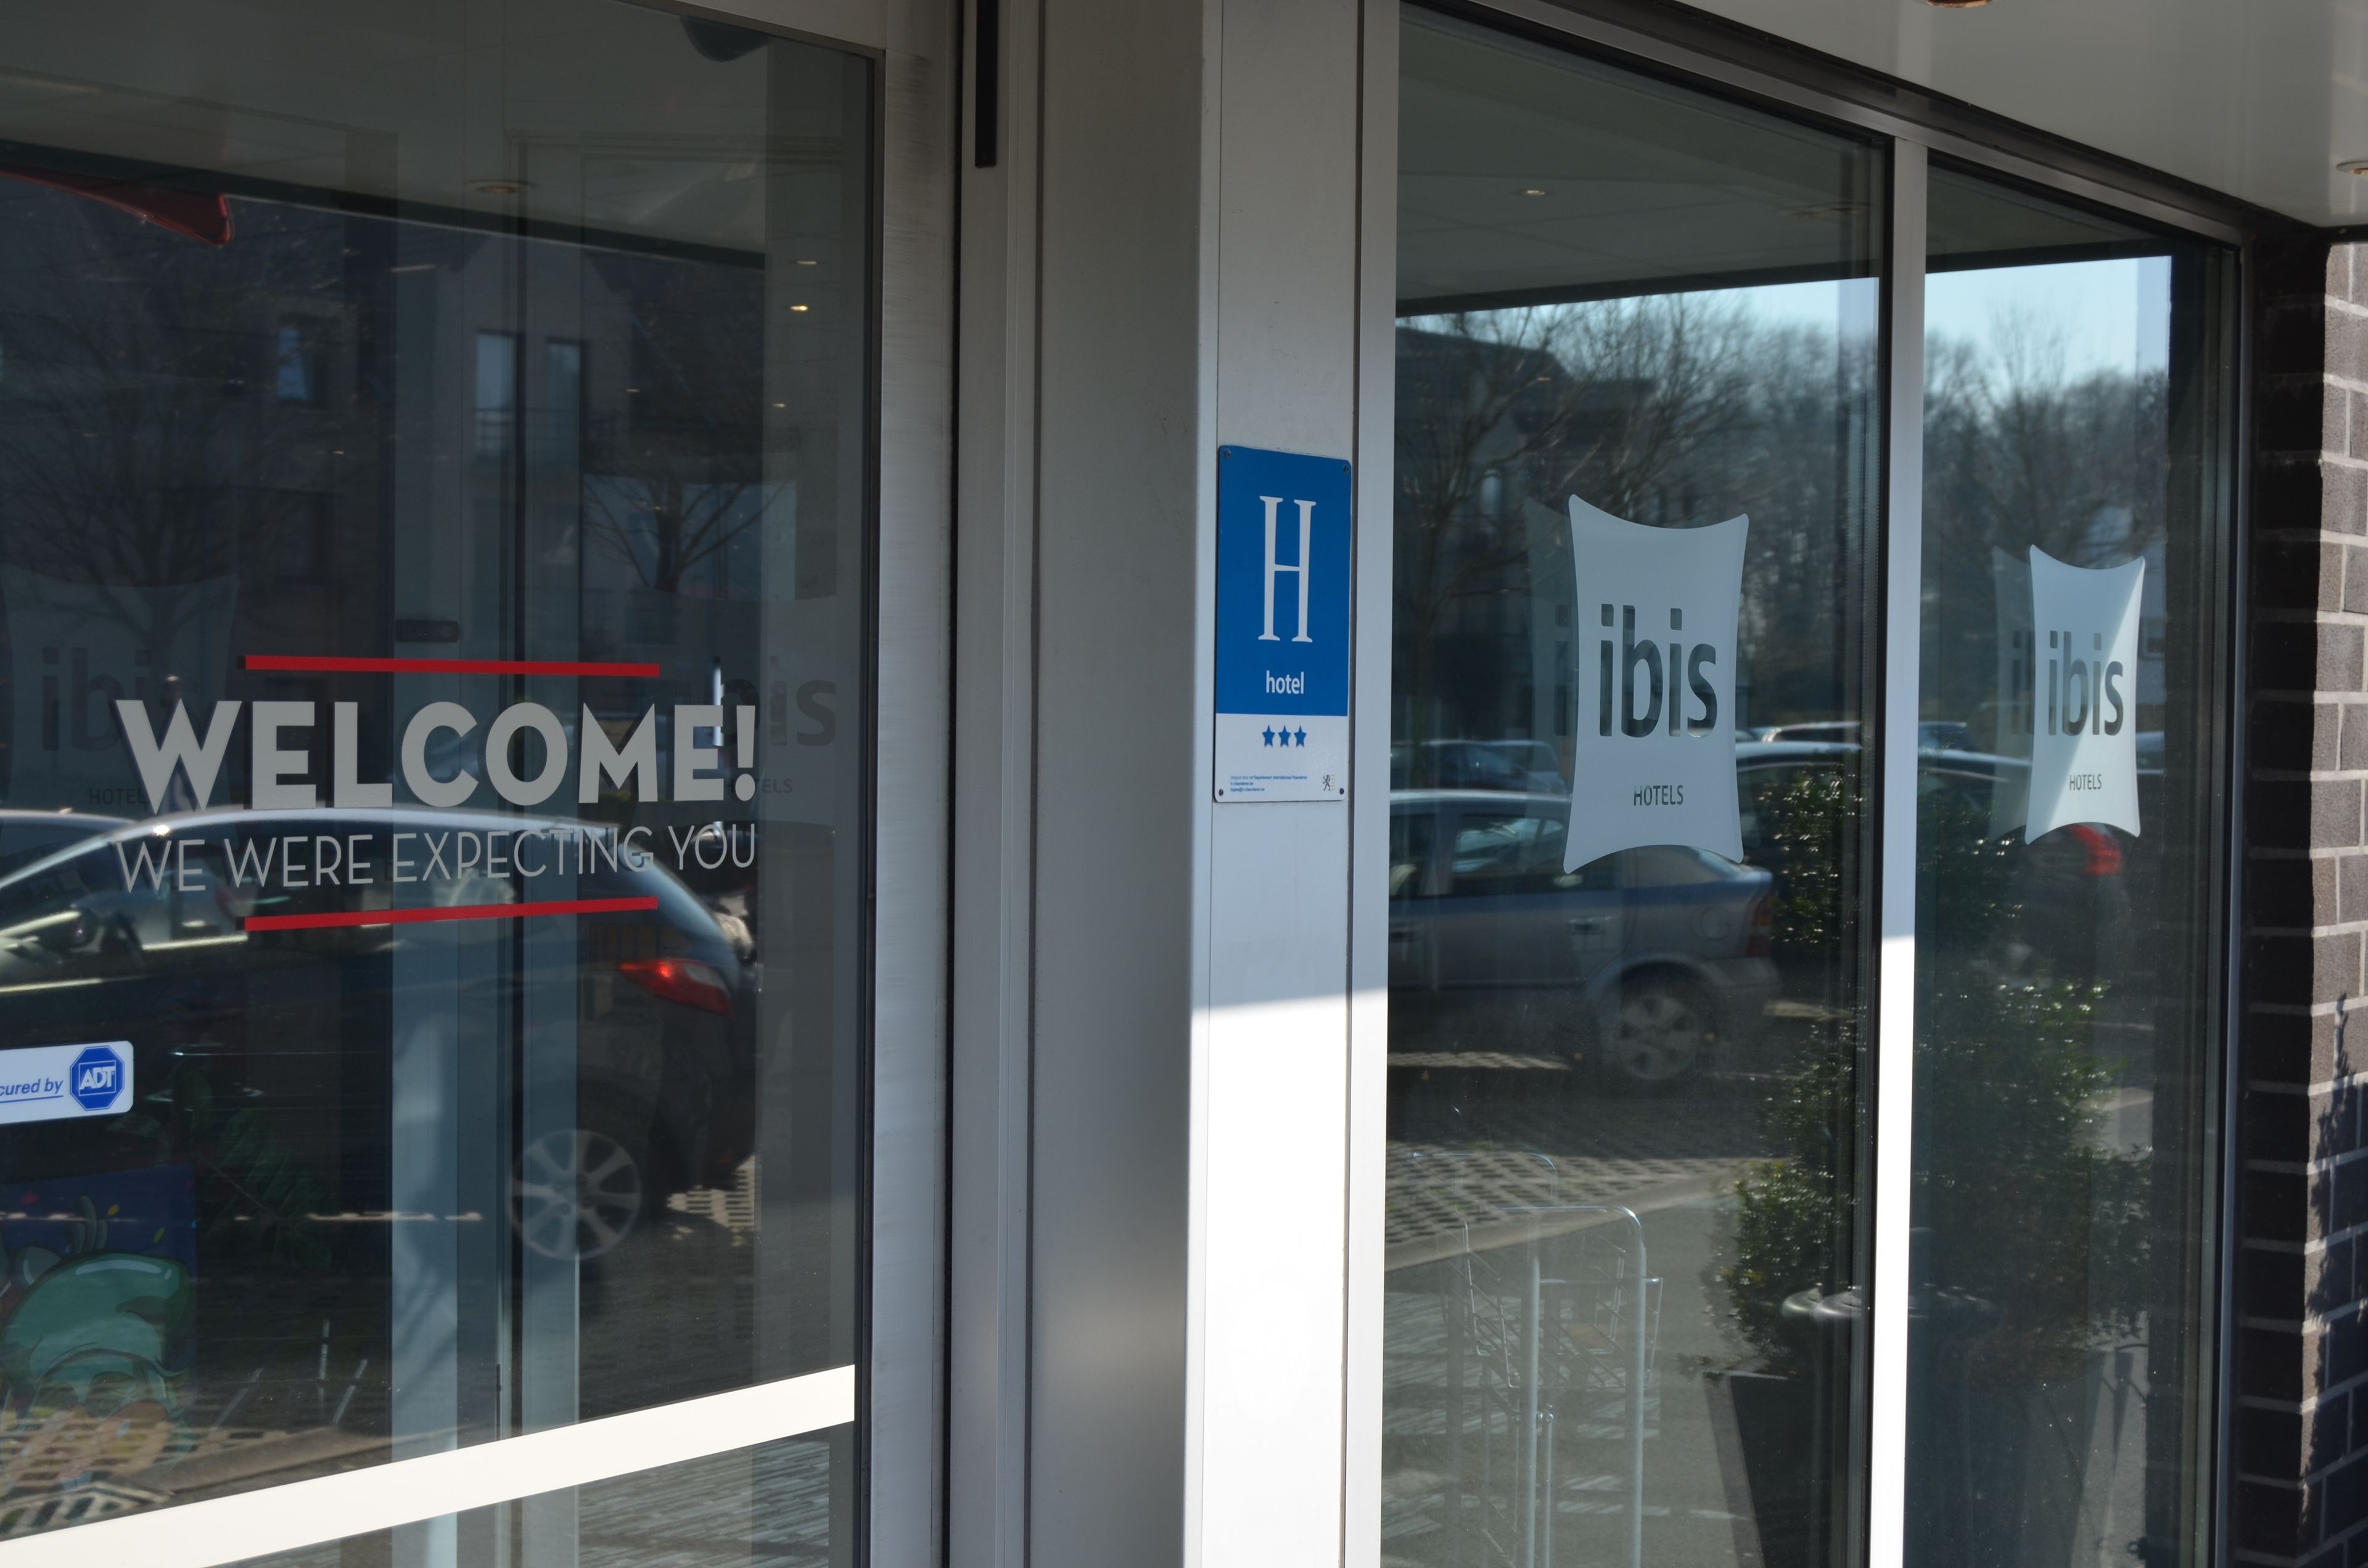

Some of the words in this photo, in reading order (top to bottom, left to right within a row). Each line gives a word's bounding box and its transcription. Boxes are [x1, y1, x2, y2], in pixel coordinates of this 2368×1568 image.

[1258, 495, 1317, 642] H
[1266, 670, 1305, 694] hotel
[1598, 604, 1718, 738] ibis
[2048, 630, 2124, 736] ibis
[116, 699, 756, 814] WELCOME!
[88, 789, 149, 805] HOTEL
[1633, 784, 1684, 807] HOTELS
[2069, 773, 2102, 791] HOTELS
[116, 839, 206, 893] WE
[224, 834, 374, 888] WERE
[393, 827, 655, 882] EXPECTING
[667, 824, 756, 870] YOU
[44, 1077, 64, 1094] by
[80, 1065, 116, 1090] ADT
